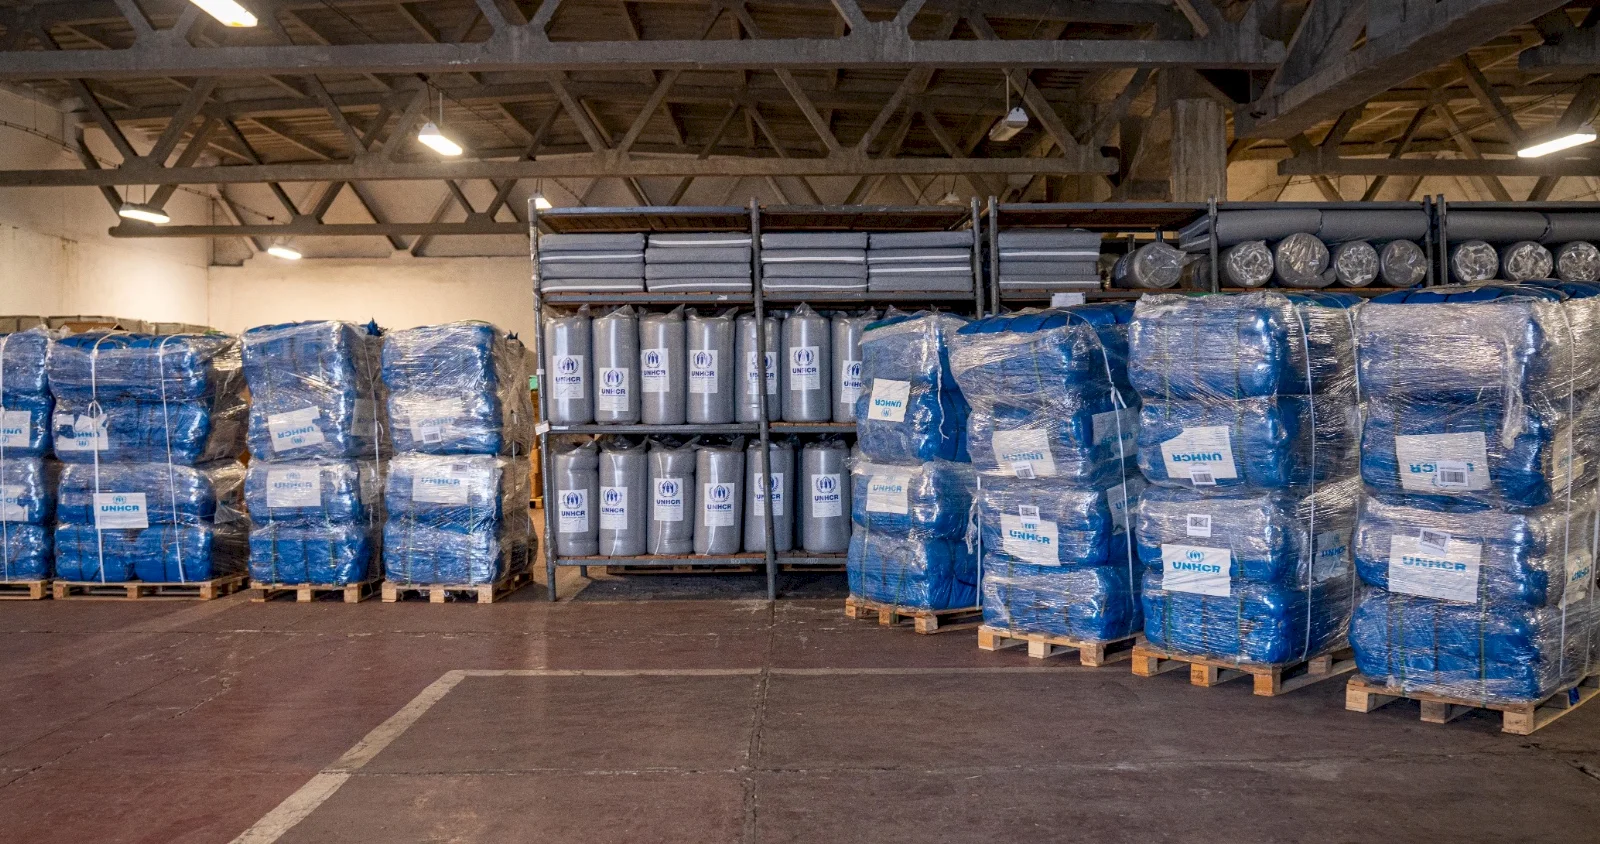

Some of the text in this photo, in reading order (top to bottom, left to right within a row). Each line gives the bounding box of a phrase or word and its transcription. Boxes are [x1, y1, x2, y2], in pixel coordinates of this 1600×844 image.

[874, 399, 902, 407] UNHCR
[277, 426, 314, 438] UNHCR
[1172, 453, 1223, 462] UNHCR
[274, 481, 312, 489] UNHCR
[873, 484, 902, 492] UNHCR
[1009, 529, 1050, 544] UNHCR
[1172, 561, 1221, 573] UNHCR
[1402, 555, 1467, 571] UNHCR
